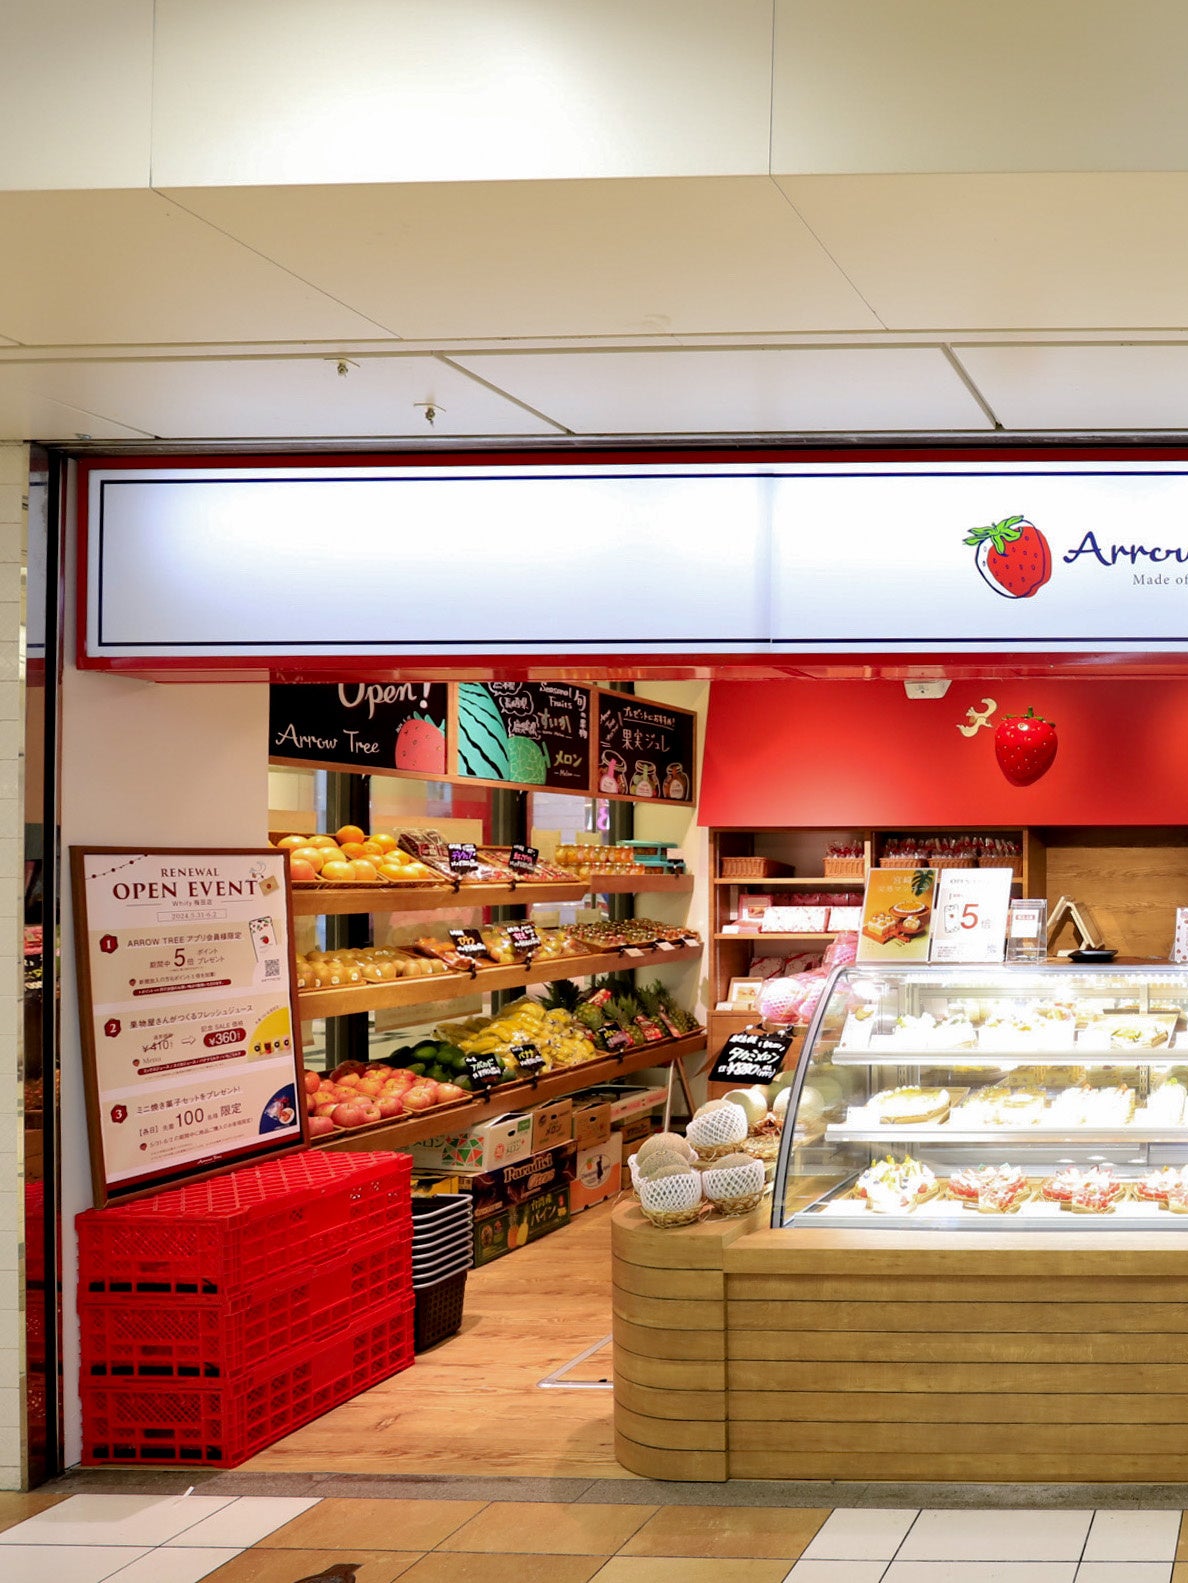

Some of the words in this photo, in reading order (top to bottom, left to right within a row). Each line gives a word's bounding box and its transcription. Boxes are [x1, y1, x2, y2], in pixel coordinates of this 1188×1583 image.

[1132, 574, 1170, 586] Made
[1175, 573, 1188, 586] of
[549, 696, 573, 709] Fruits
[537, 708, 572, 733] すいか
[275, 723, 338, 749] Arrow
[343, 729, 380, 753] Tree
[553, 750, 582, 768] メロン
[161, 868, 219, 878] RENEWAL
[112, 882, 178, 900] OPEN
[188, 880, 258, 898] EVENT
[960, 903, 980, 930] 5
[127, 937, 160, 947] ARROW
[163, 936, 186, 945] TREE
[173, 948, 186, 967] 5
[129, 1005, 254, 1029] 果物屋さんがつくるフレッシュジュース
[109, 1024, 117, 1033] 2
[208, 1031, 237, 1047] ¥360
[116, 1109, 123, 1119] 3
[175, 1107, 205, 1128] 100
[220, 1103, 242, 1117] 限定
